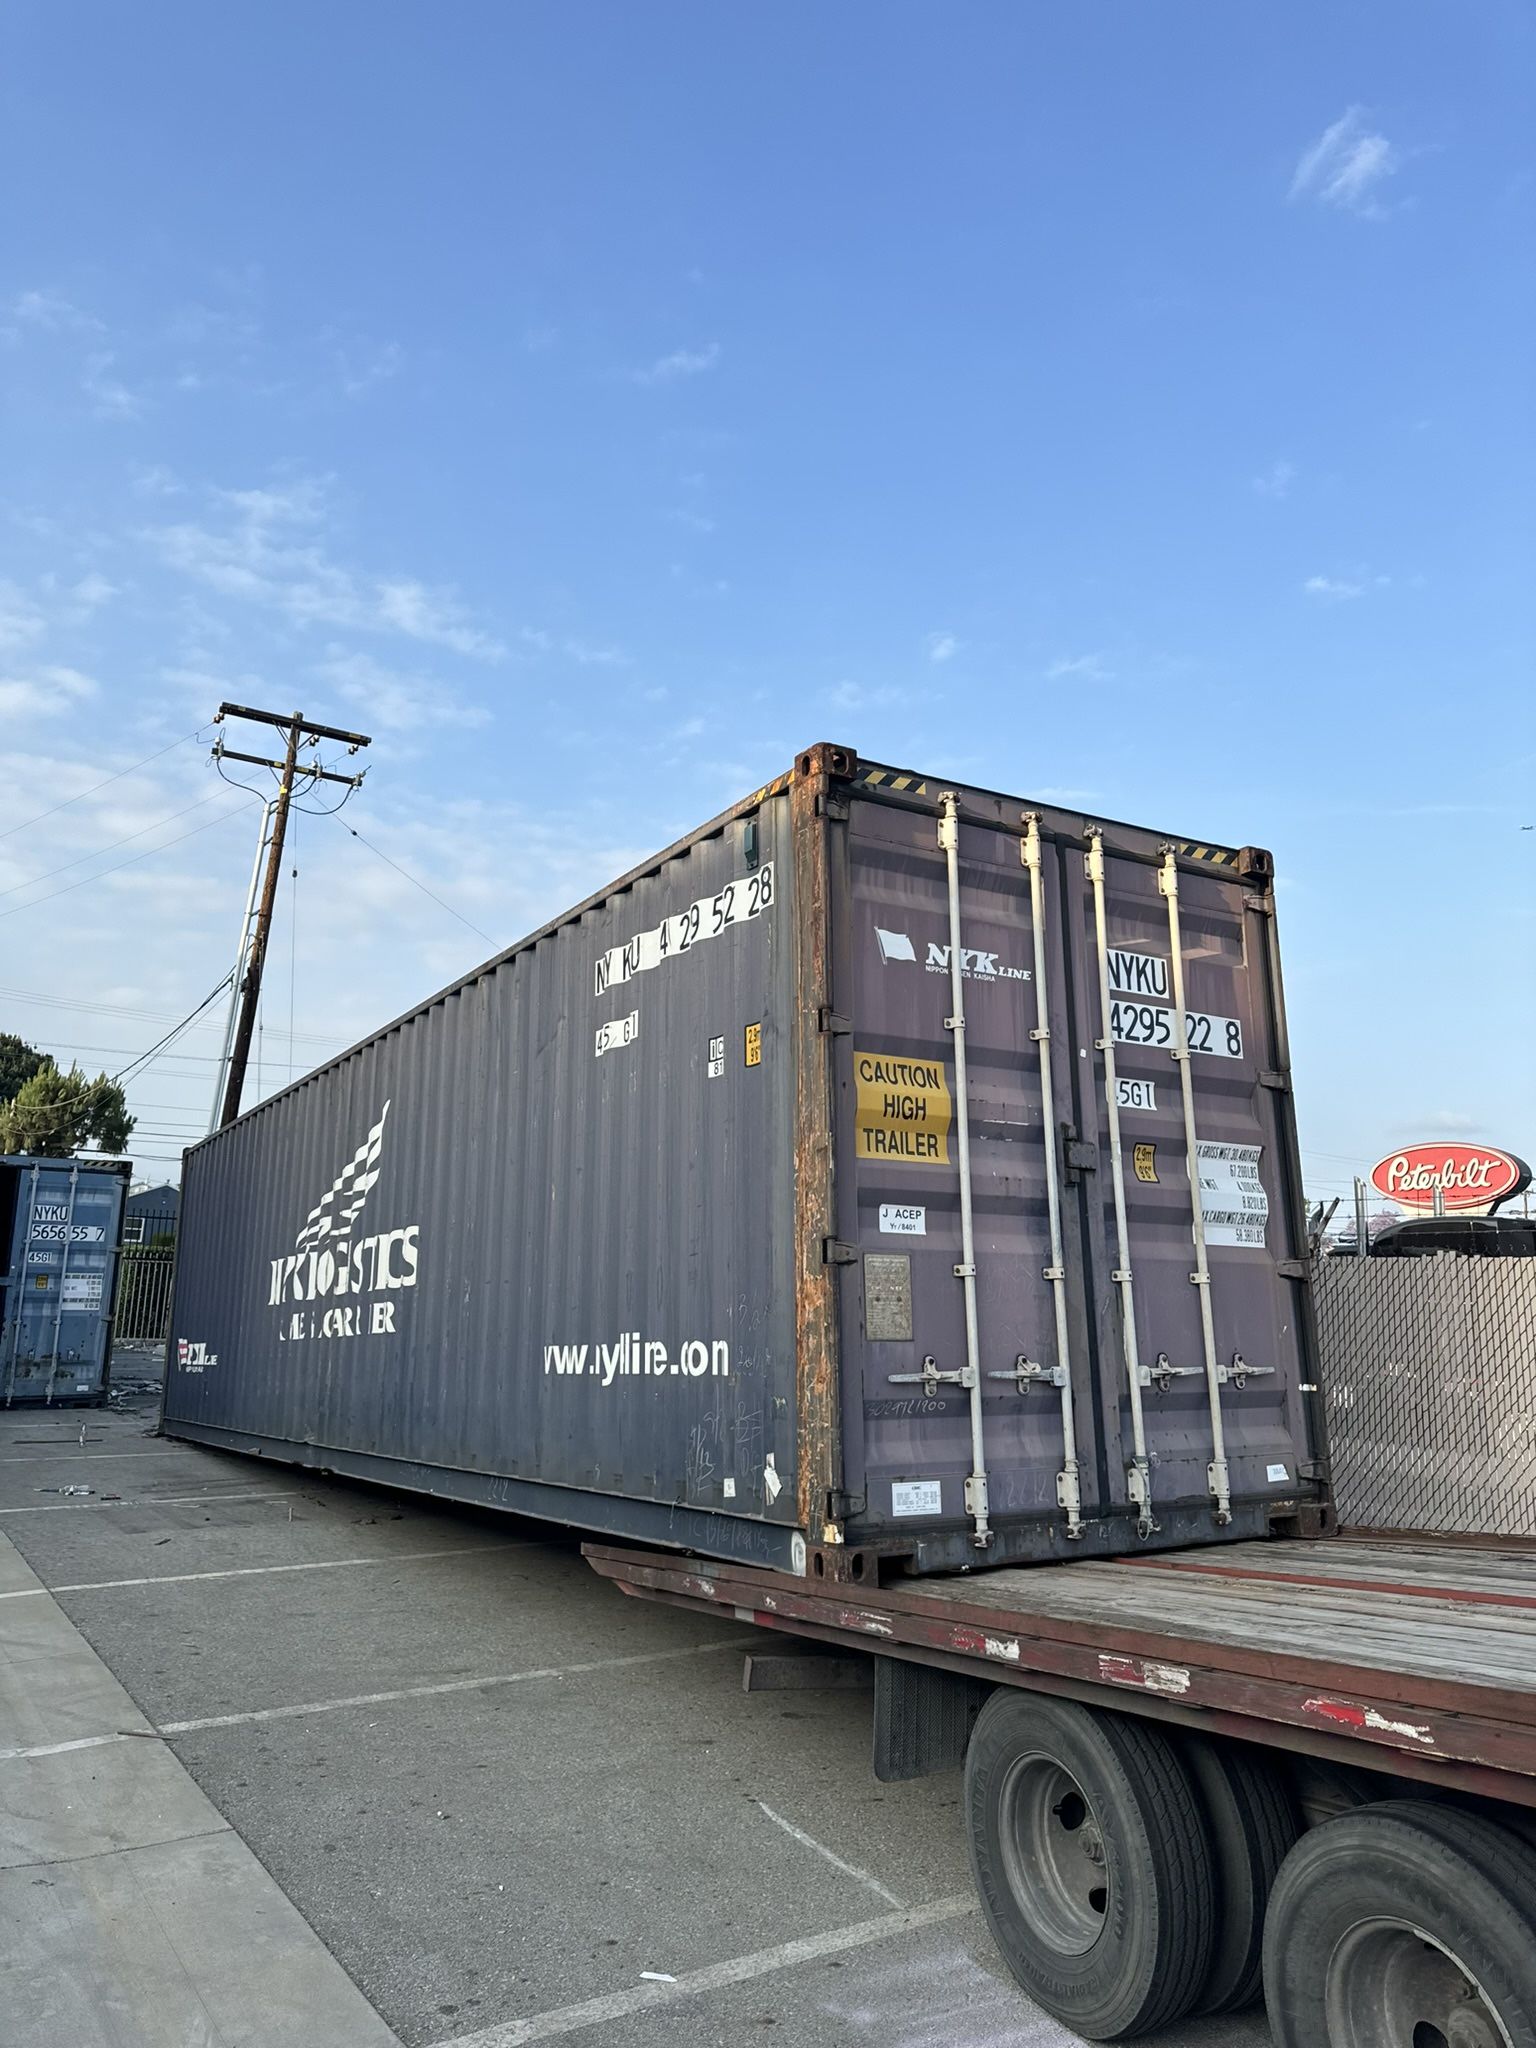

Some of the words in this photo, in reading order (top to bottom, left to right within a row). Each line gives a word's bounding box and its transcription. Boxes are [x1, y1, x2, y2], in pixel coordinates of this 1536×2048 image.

[925, 965, 949, 975] NIPPON
[998, 966, 1032, 981] LINE
[1107, 951, 1167, 996] NYKU
[859, 1059, 941, 1090] CAUTION
[883, 1093, 927, 1121] HIGH
[1116, 1080, 1152, 1108] 5G1
[862, 1127, 939, 1158] TRAILER
[1387, 1156, 1503, 1193] Peterbilt
[33, 1205, 69, 1221] NYKU
[894, 1209, 922, 1220] ACEP
